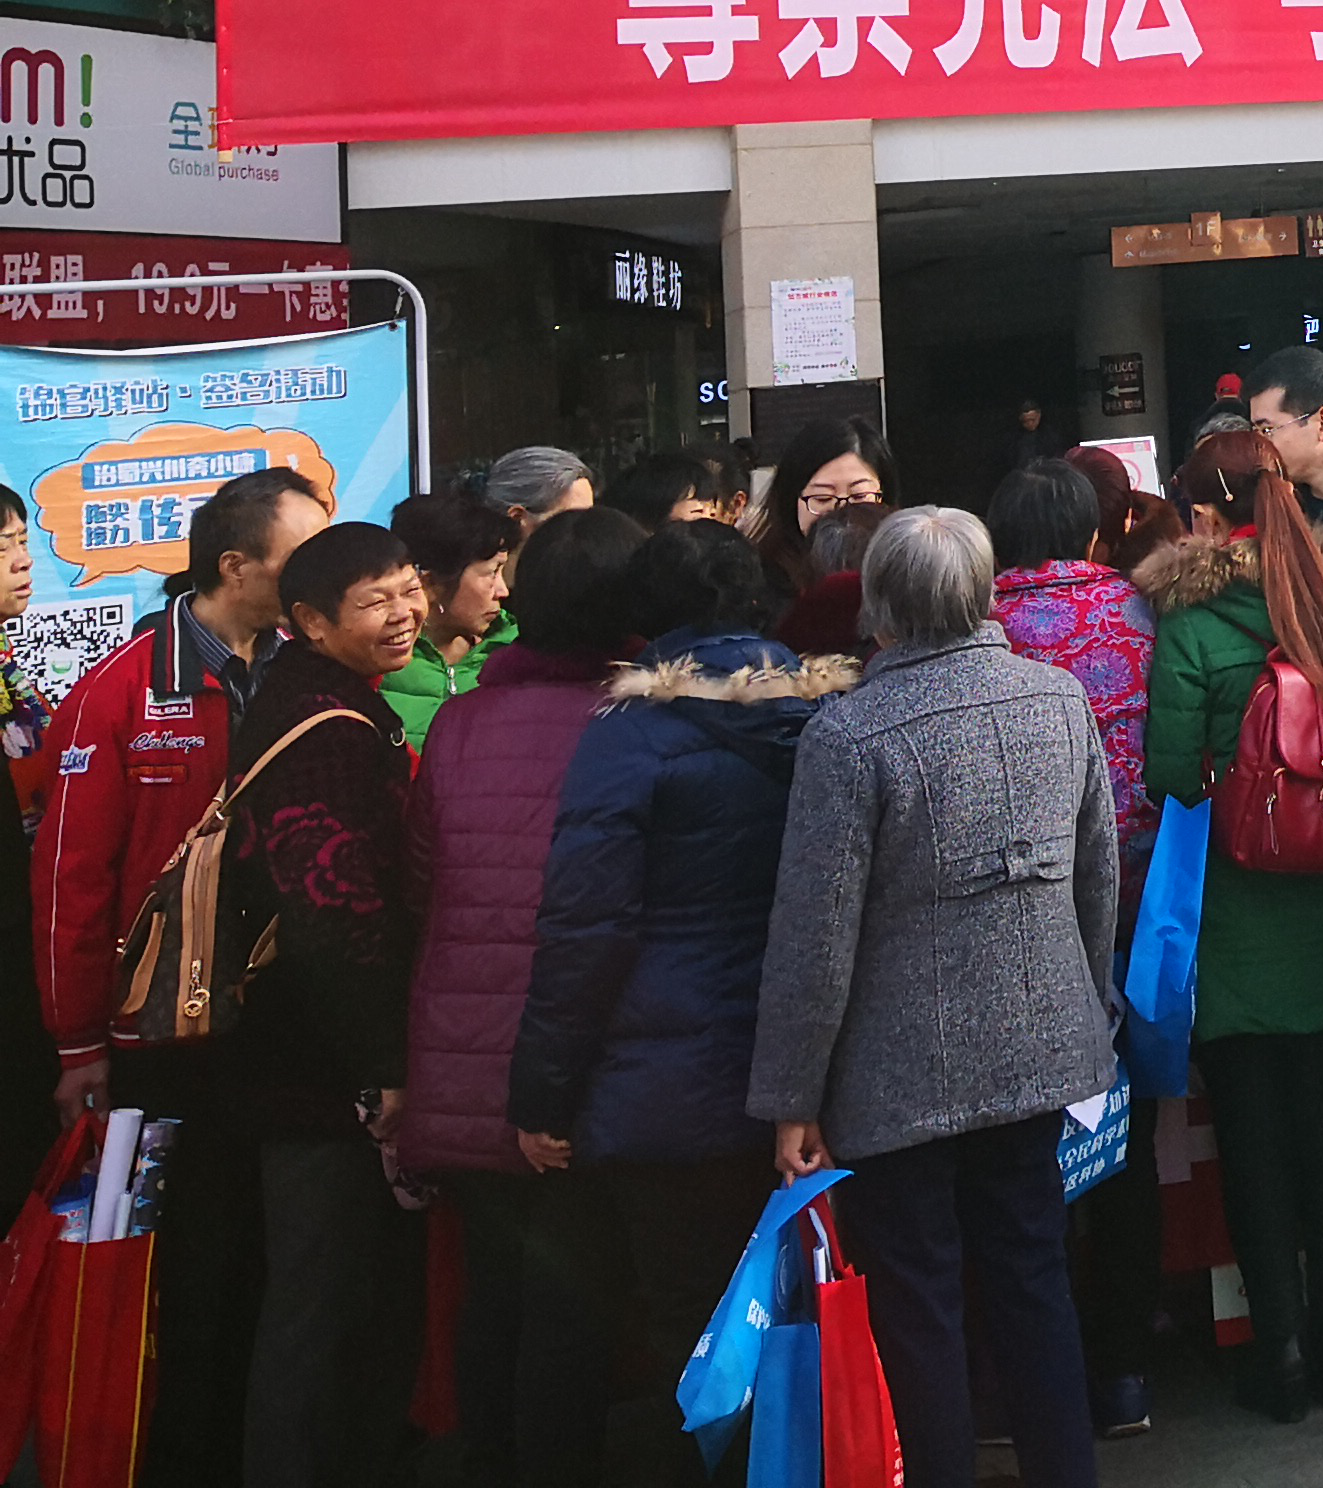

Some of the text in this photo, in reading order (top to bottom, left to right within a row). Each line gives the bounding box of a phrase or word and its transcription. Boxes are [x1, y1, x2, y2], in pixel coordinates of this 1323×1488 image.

[168, 158, 280, 183] Global purchase
[614, 250, 683, 311] 丽缘鞋坊
